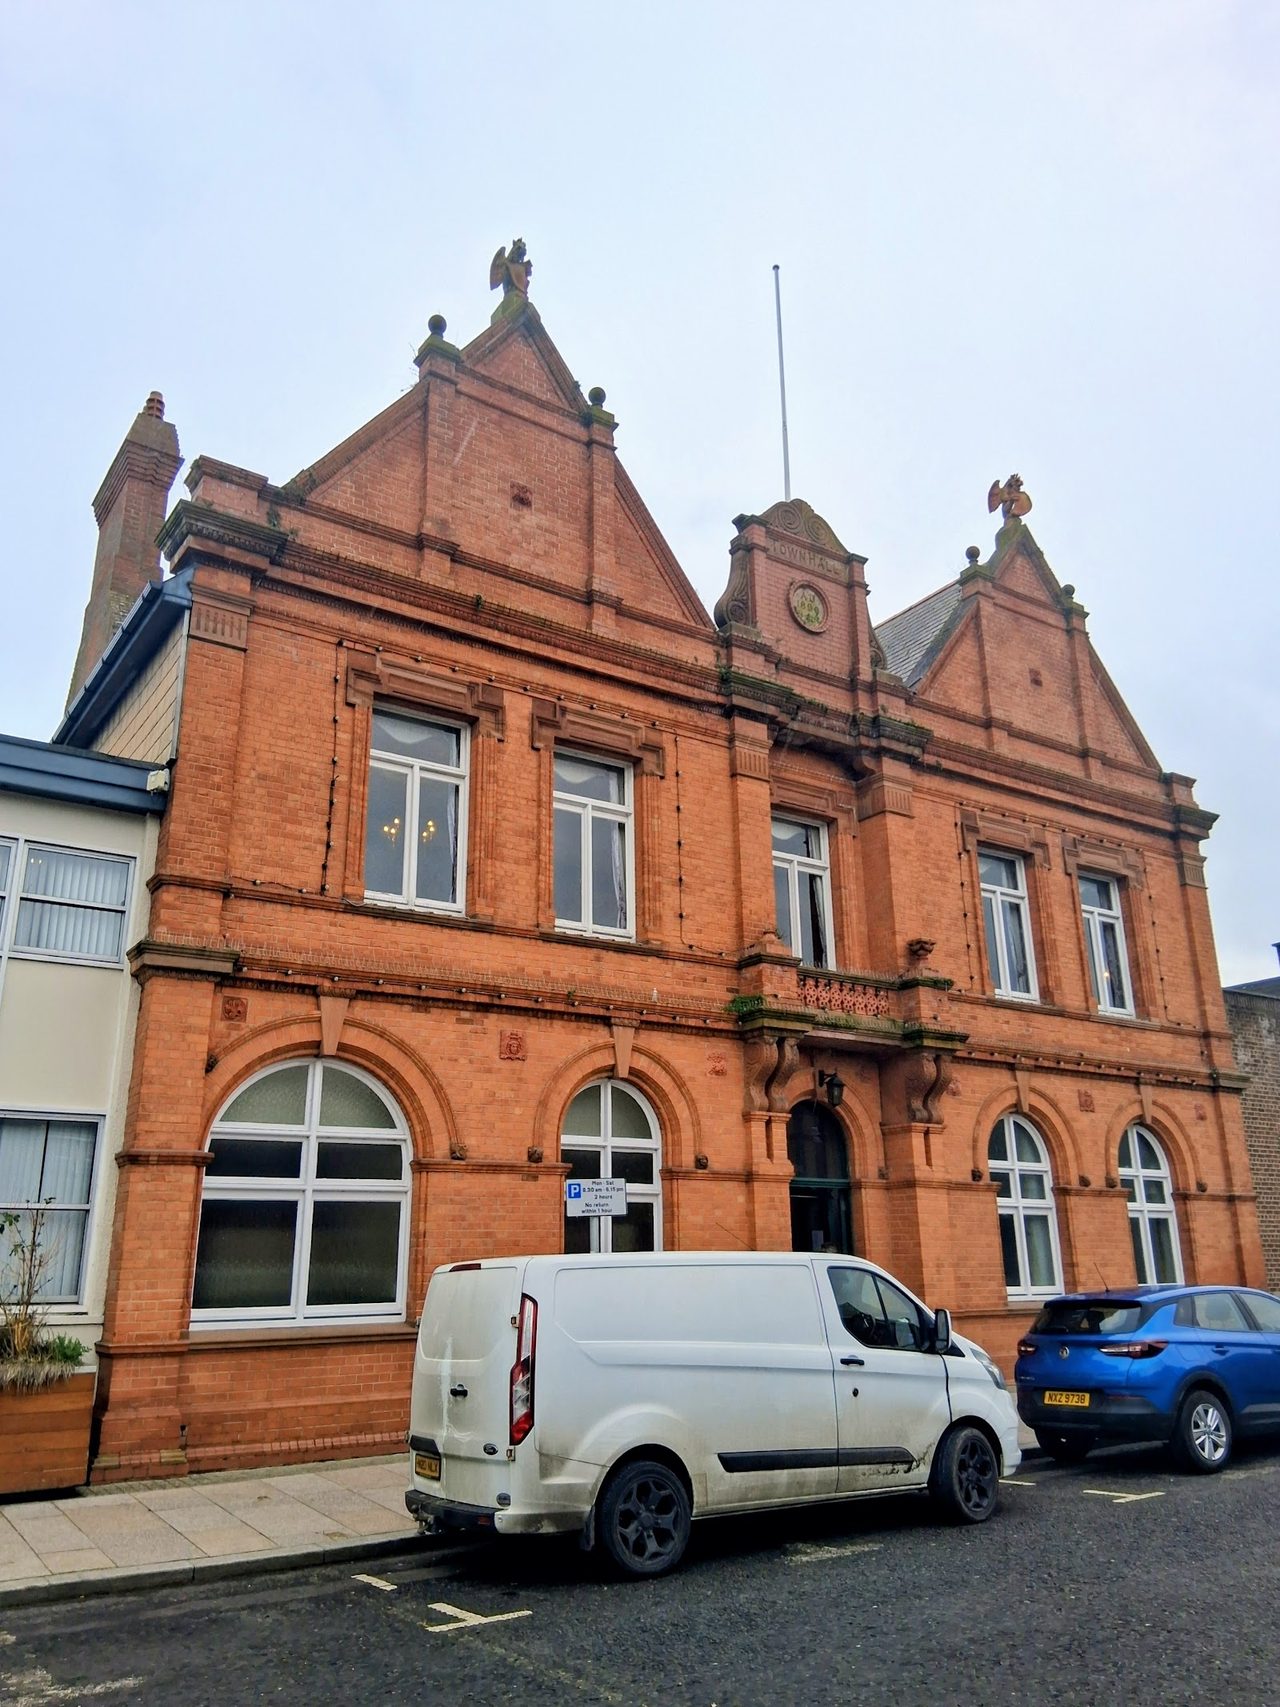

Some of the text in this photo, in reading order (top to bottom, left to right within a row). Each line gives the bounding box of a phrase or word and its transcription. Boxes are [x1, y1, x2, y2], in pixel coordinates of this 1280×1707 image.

[571, 1185, 579, 1197] P
[1048, 1393, 1086, 1404] NXZ 9738
